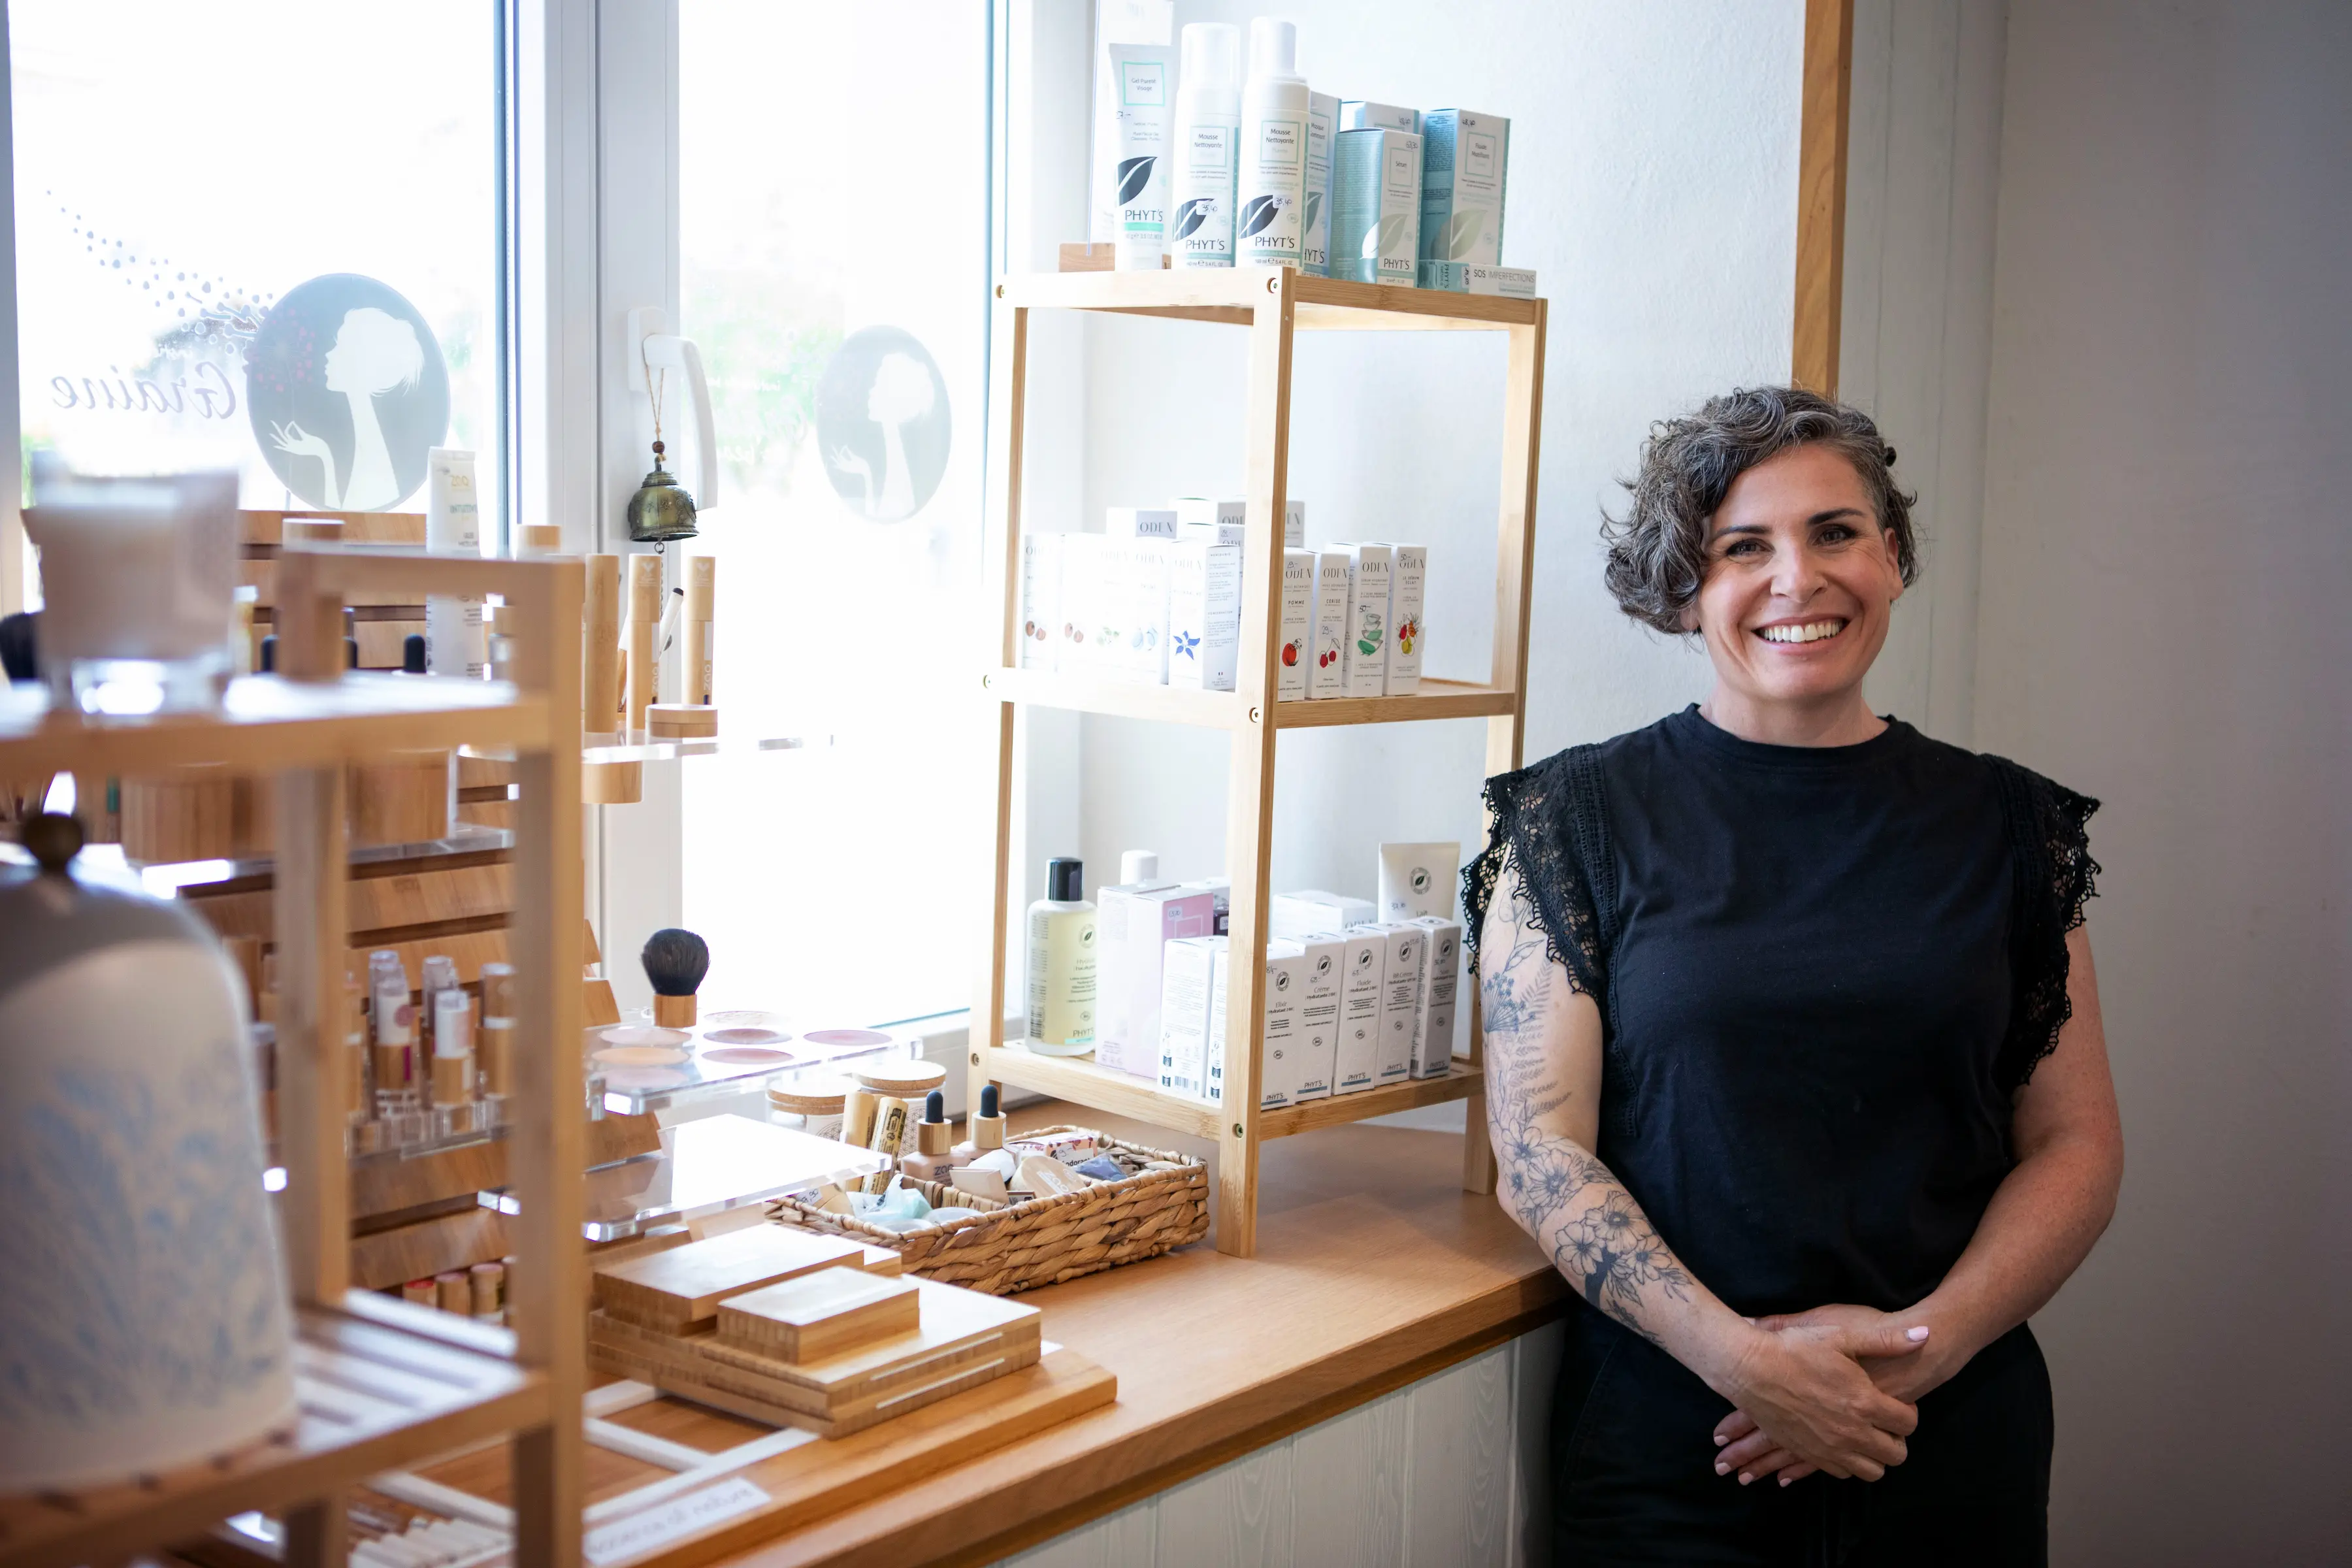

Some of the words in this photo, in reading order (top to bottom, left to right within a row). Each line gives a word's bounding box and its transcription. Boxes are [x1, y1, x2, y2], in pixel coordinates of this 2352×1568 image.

[1396, 160, 1408, 169] Sérum
[1125, 209, 1163, 222] PHYT'S
[1186, 238, 1226, 251] PHYT'S
[1254, 236, 1296, 249] PHYT'S
[1383, 258, 1410, 270] PHYT'S
[1473, 269, 1486, 278] SOS
[1488, 270, 1535, 284] IMPERFECTIONS
[1139, 521, 1173, 534] ODEN
[1323, 567, 1347, 578] ODEN
[1362, 562, 1388, 572] ODEN
[1386, 1063, 1403, 1071] PHYT'S
[1348, 1072, 1366, 1081] PHYT'S
[1304, 1079, 1322, 1089] PHYT'S
[1266, 1092, 1284, 1102] PHYT'S
